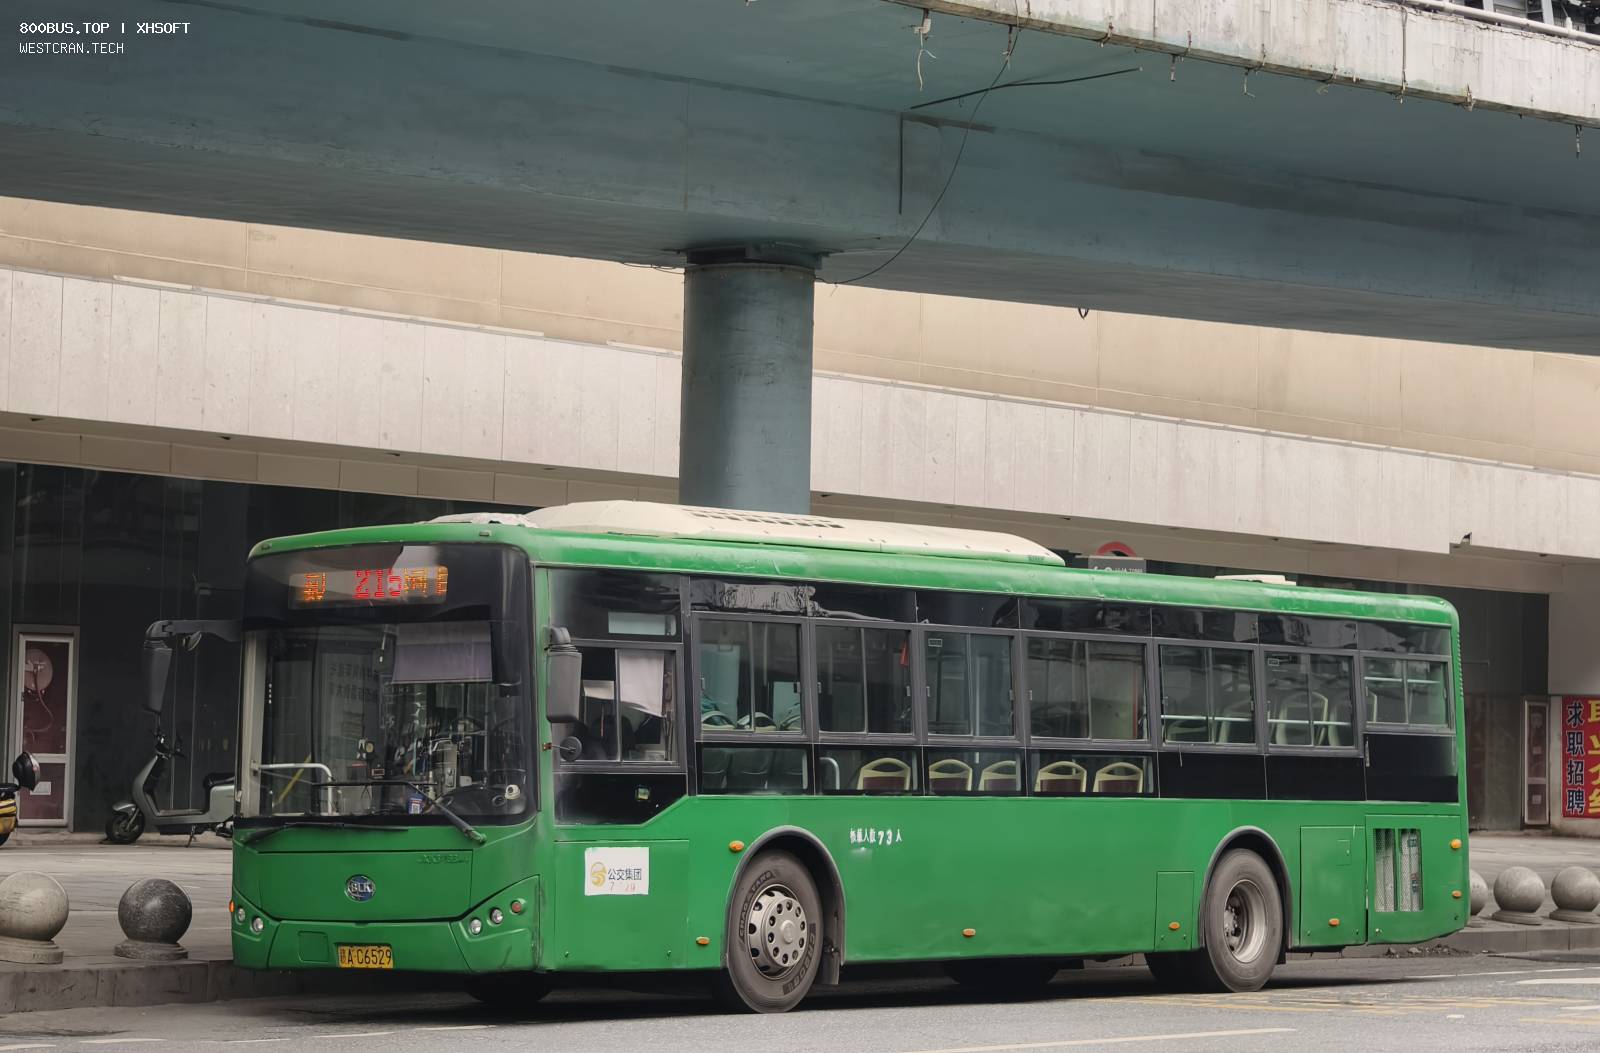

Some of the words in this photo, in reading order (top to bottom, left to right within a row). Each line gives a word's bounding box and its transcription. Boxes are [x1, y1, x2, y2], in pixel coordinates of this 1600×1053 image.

[1566, 701, 1585, 815] 求职招聘
[608, 868, 642, 881] 公交集团
